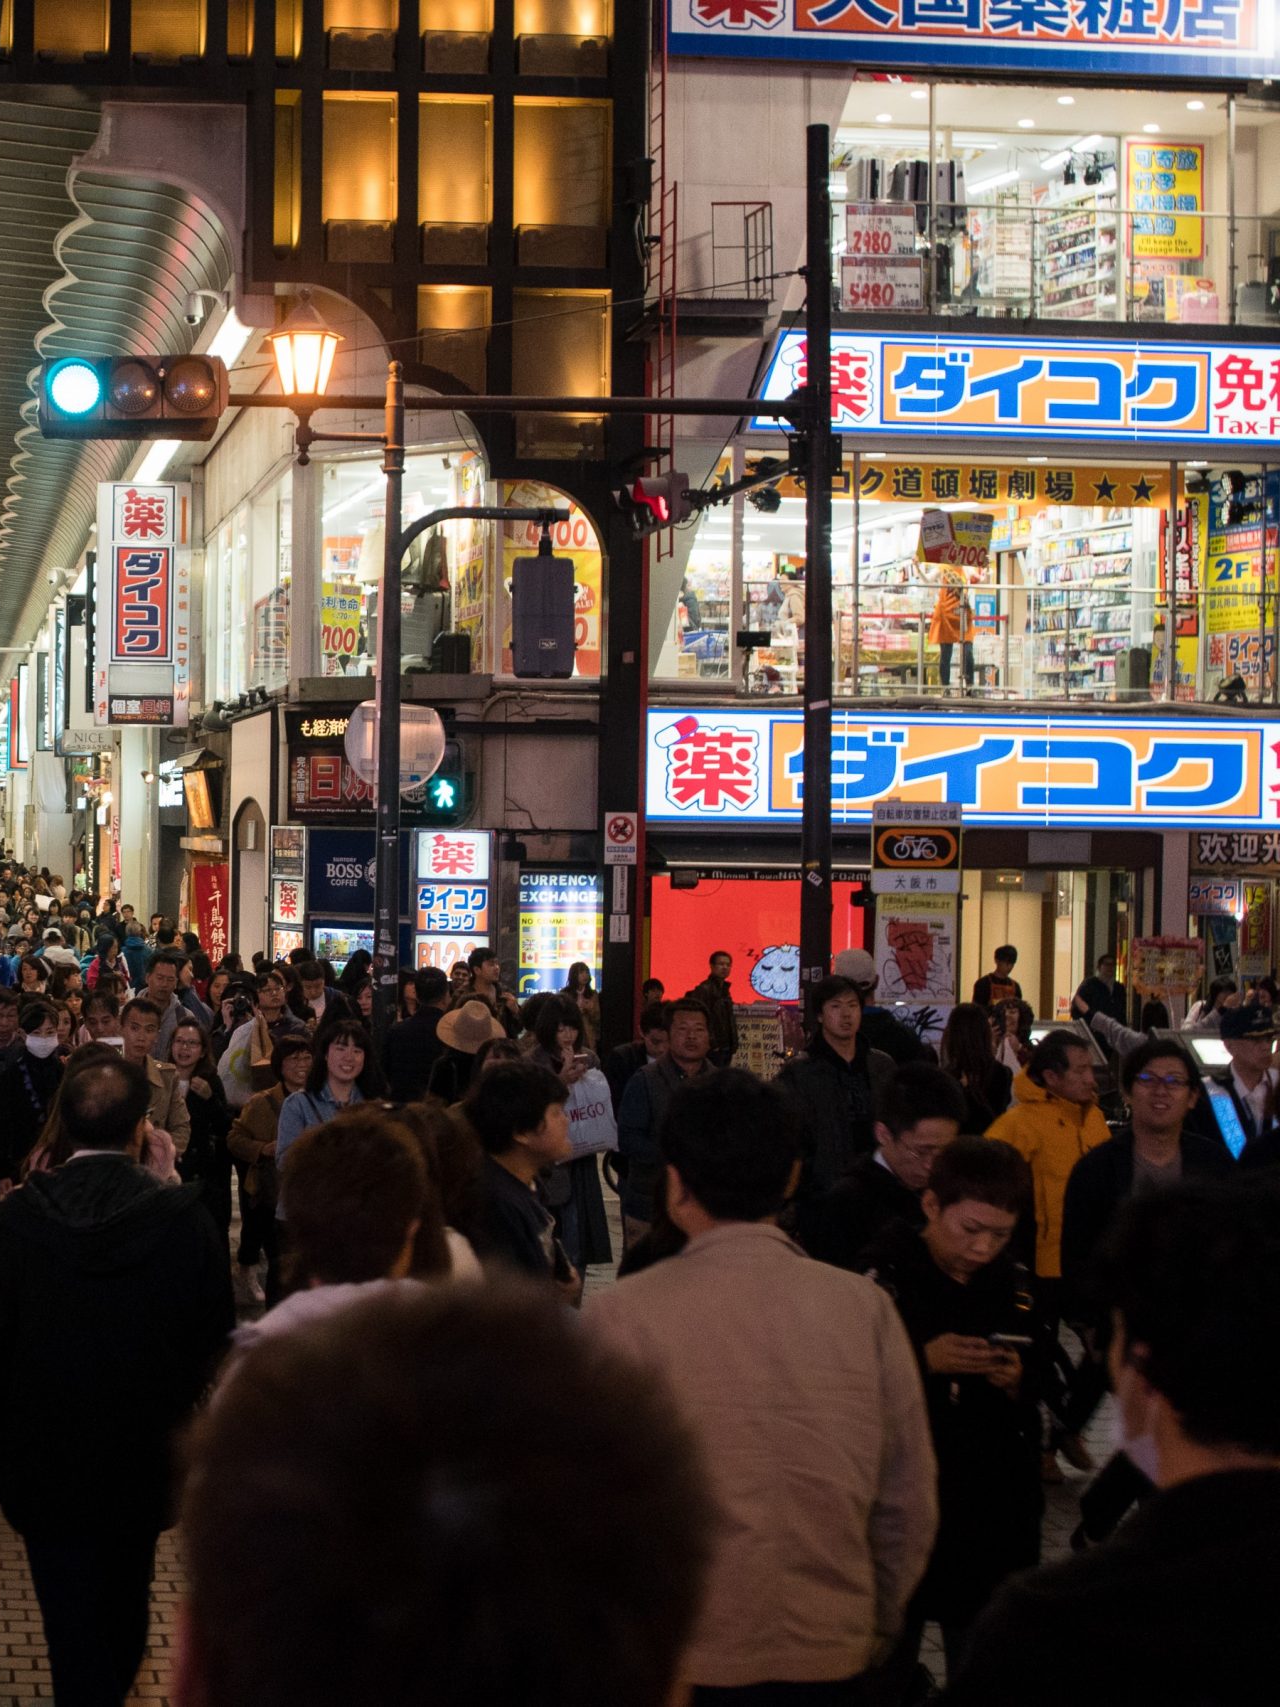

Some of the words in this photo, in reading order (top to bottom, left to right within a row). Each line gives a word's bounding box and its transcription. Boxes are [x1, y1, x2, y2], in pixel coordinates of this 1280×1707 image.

[1138, 246, 1173, 255] baggage
[1174, 246, 1193, 254] here
[1153, 238, 1173, 248] keep
[1174, 238, 1188, 246] the
[894, 351, 1198, 422] ダイコク
[1214, 354, 1280, 412] 免
[124, 488, 165, 538] 薬
[1214, 557, 1250, 582] 2F
[123, 552, 163, 653] ダイコク
[74, 731, 105, 744] NICE
[672, 720, 754, 810] 薬
[789, 731, 1245, 808] ダイコク
[431, 834, 475, 875] 薬
[326, 863, 363, 878] BOSS
[330, 879, 358, 887] COFFEE
[520, 874, 597, 887] CURRENCY
[894, 874, 937, 889] 大阪市
[418, 886, 488, 911] ダイコク
[519, 890, 597, 903] EXCHANGE
[426, 912, 477, 931] ドラッグ
[569, 1101, 606, 1123] WEGO
